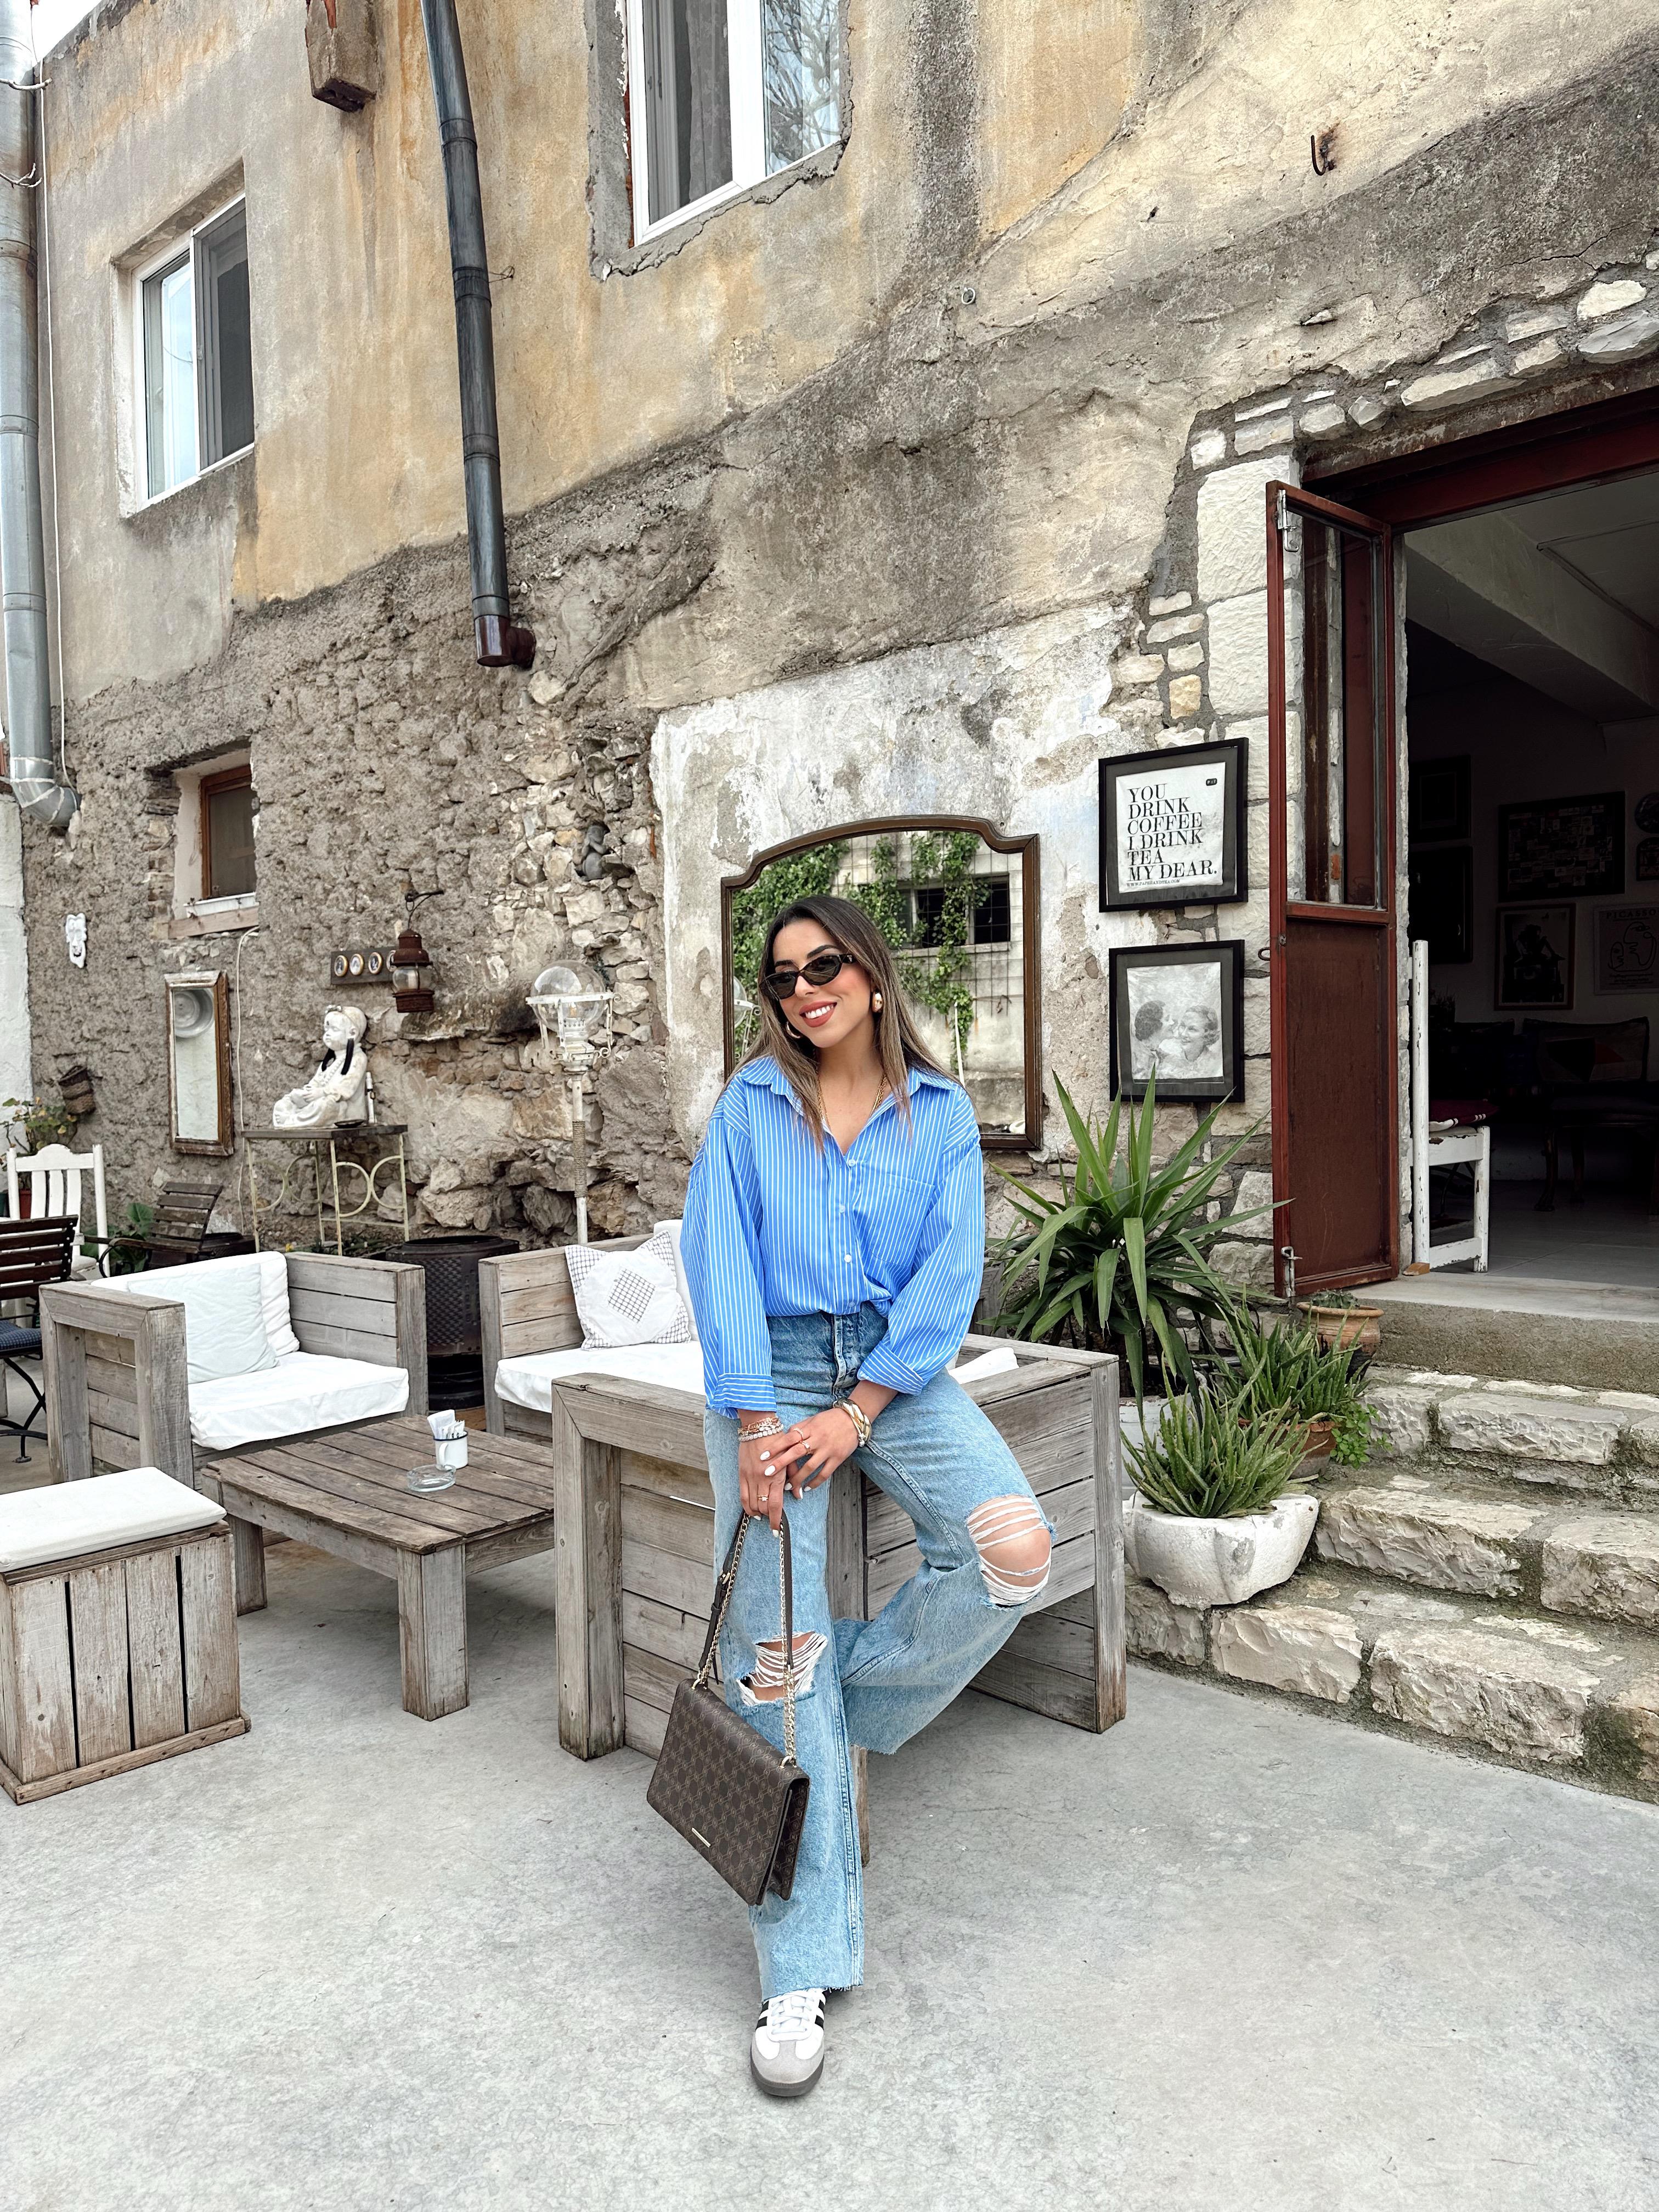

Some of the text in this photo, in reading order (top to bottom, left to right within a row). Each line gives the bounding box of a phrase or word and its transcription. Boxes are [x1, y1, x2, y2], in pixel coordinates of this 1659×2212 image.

[1127, 783, 1167, 803] YOU
[1128, 797, 1190, 819] DRINK
[1127, 812, 1203, 835] COFFEE
[1127, 828, 1204, 850] I DRINK
[1127, 848, 1165, 866] TEA
[1127, 860, 1217, 882] MY DEAR.
[1606, 908, 1656, 919] PICASSO
